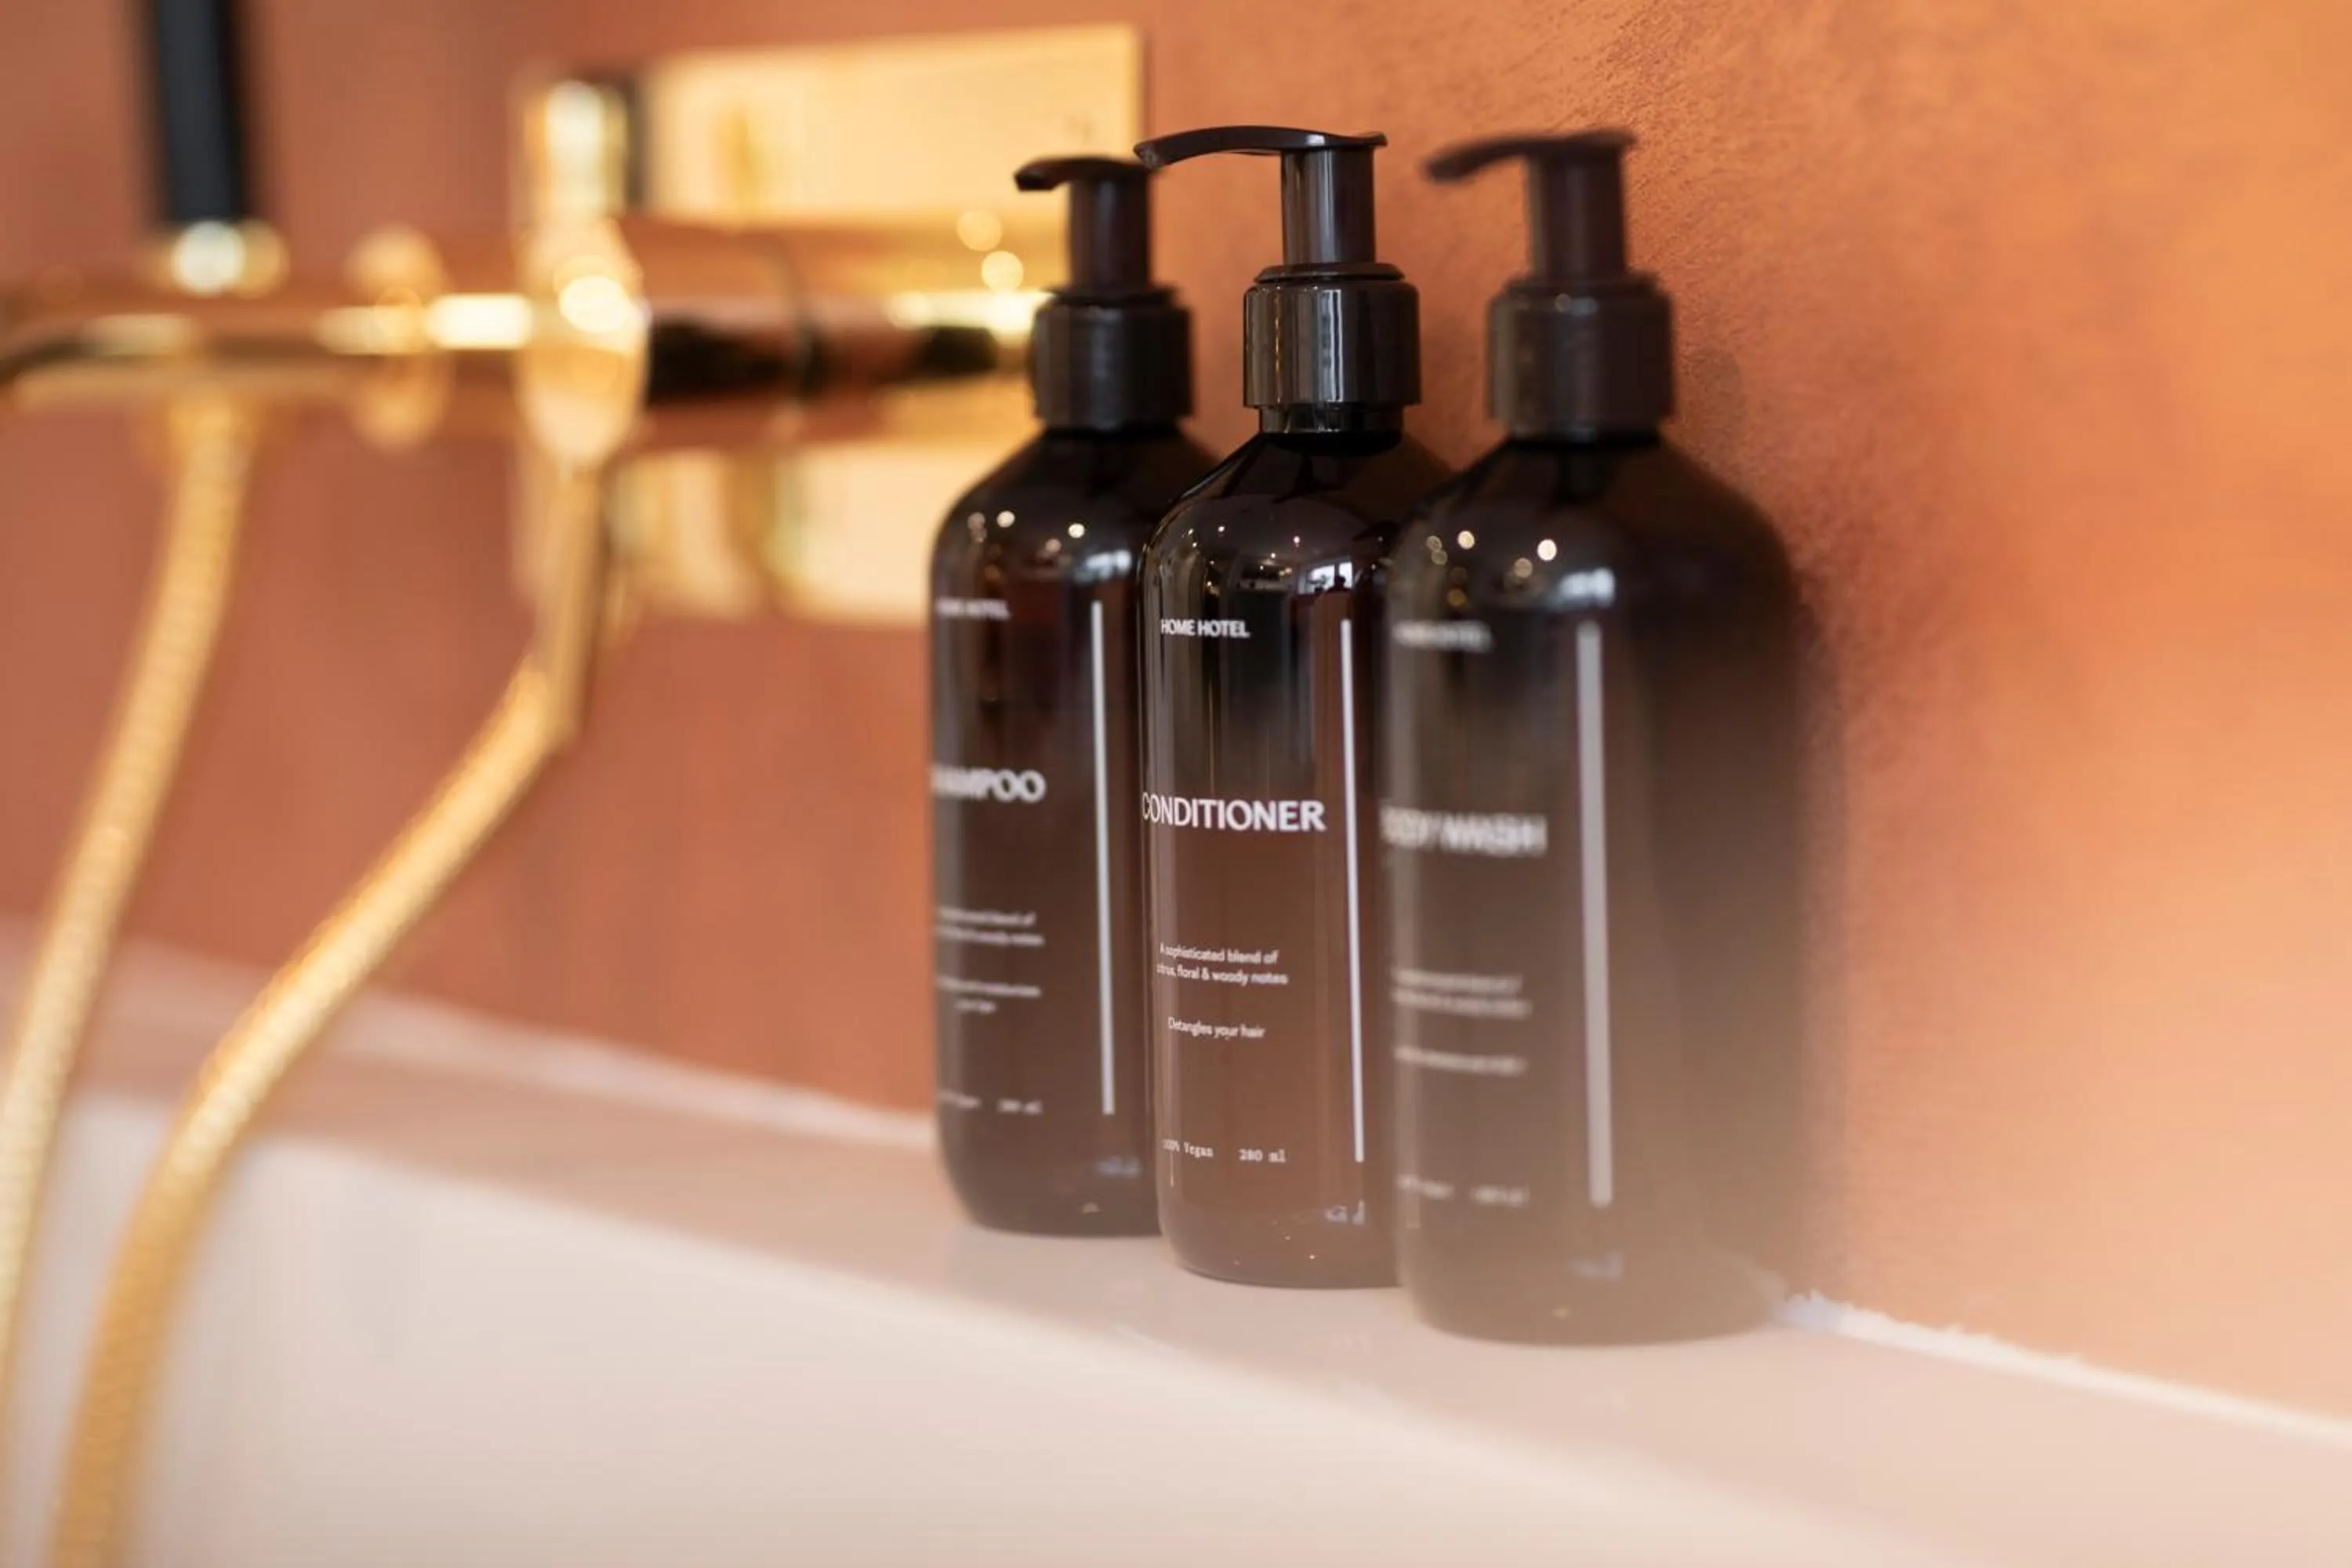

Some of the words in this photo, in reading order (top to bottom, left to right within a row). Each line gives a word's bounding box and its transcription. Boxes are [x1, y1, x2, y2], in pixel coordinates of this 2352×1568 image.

[1160, 619, 1196, 636] HOME
[1197, 619, 1250, 638] HOTEL
[1142, 792, 1327, 832] CONDITIONER
[1165, 944, 1225, 962] sophisticated
[1227, 948, 1261, 964] blend
[1263, 949, 1279, 964] of
[1177, 964, 1200, 979] floral
[1201, 967, 1210, 981] &
[1211, 969, 1249, 987] woody
[1250, 972, 1289, 985] notes
[1167, 1016, 1213, 1036] Detangles
[1214, 1025, 1238, 1039] your
[1240, 1022, 1266, 1038] hair
[1183, 1141, 1214, 1158] Vegan
[1268, 1148, 1287, 1163] ml
